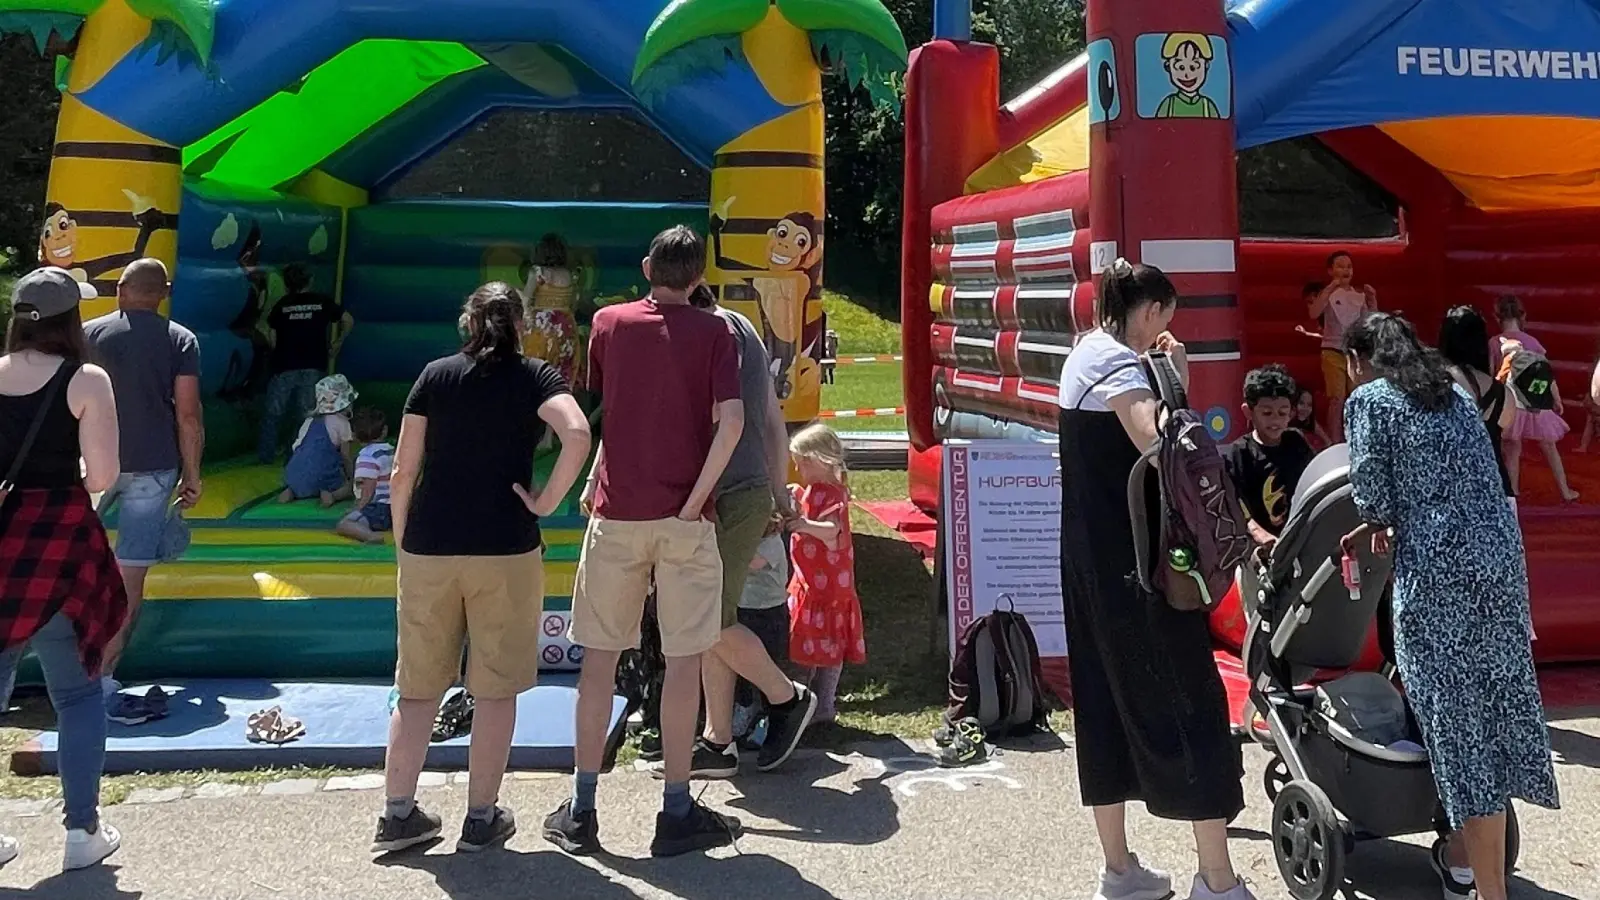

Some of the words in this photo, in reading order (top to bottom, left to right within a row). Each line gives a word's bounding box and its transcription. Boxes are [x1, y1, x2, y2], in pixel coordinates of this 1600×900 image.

[1397, 46, 1600, 79] FEUERWEH
[979, 475, 1062, 488] HÜPFBUR
[954, 489, 968, 569] OFFENEN
[957, 574, 970, 611] DER
